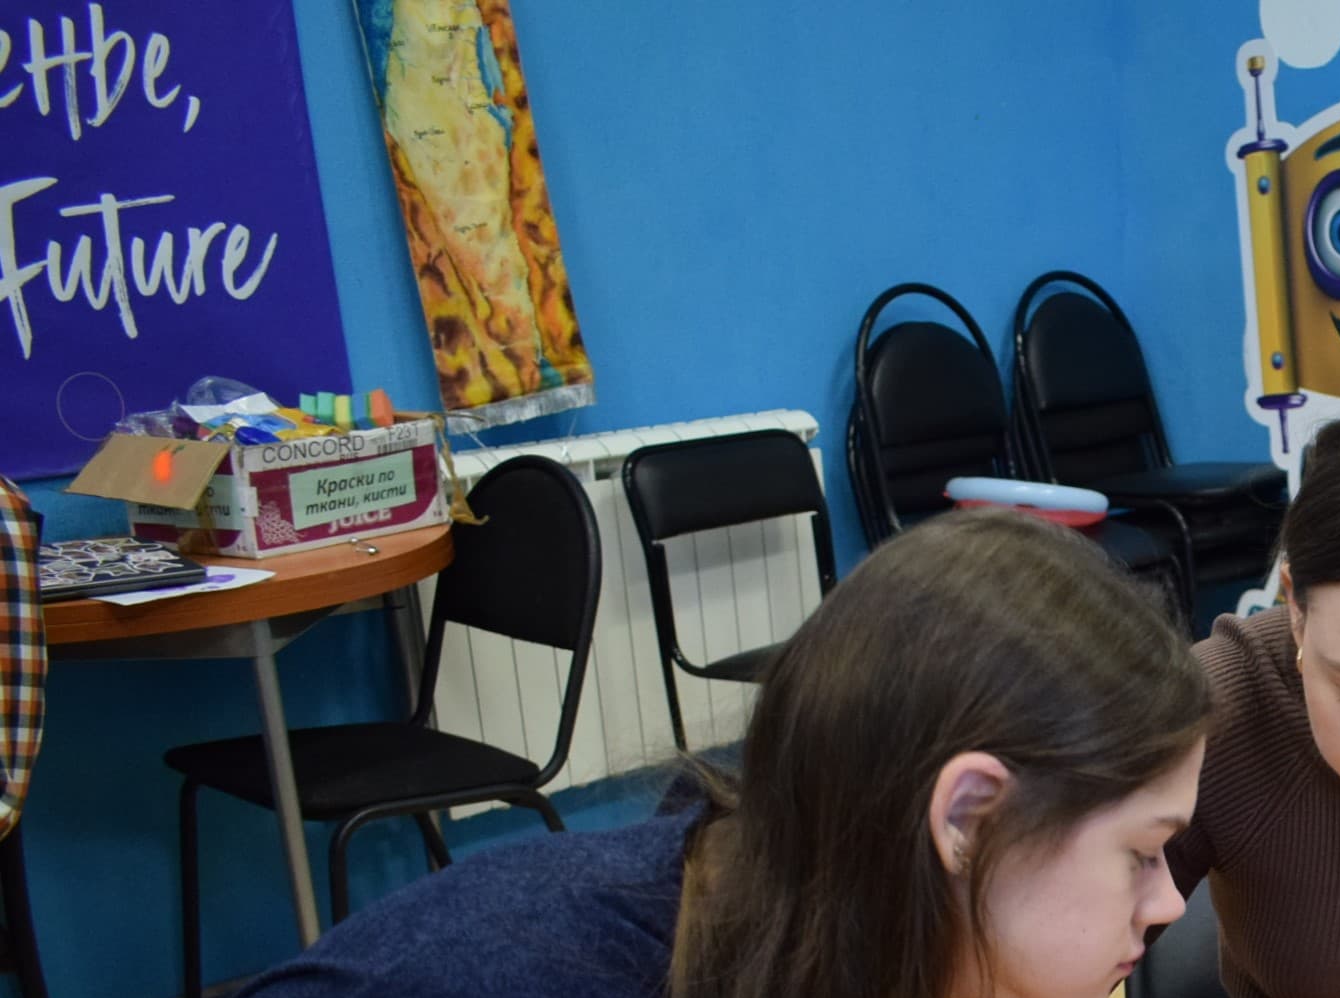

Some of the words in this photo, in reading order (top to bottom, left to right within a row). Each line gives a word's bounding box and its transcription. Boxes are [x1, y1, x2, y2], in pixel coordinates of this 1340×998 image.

[0, 177, 278, 360] Future
[262, 435, 366, 464] CONCORD
[316, 473, 375, 497] Краски
[378, 468, 396, 484] по
[305, 496, 360, 516] ткани,
[363, 483, 408, 504] кисти
